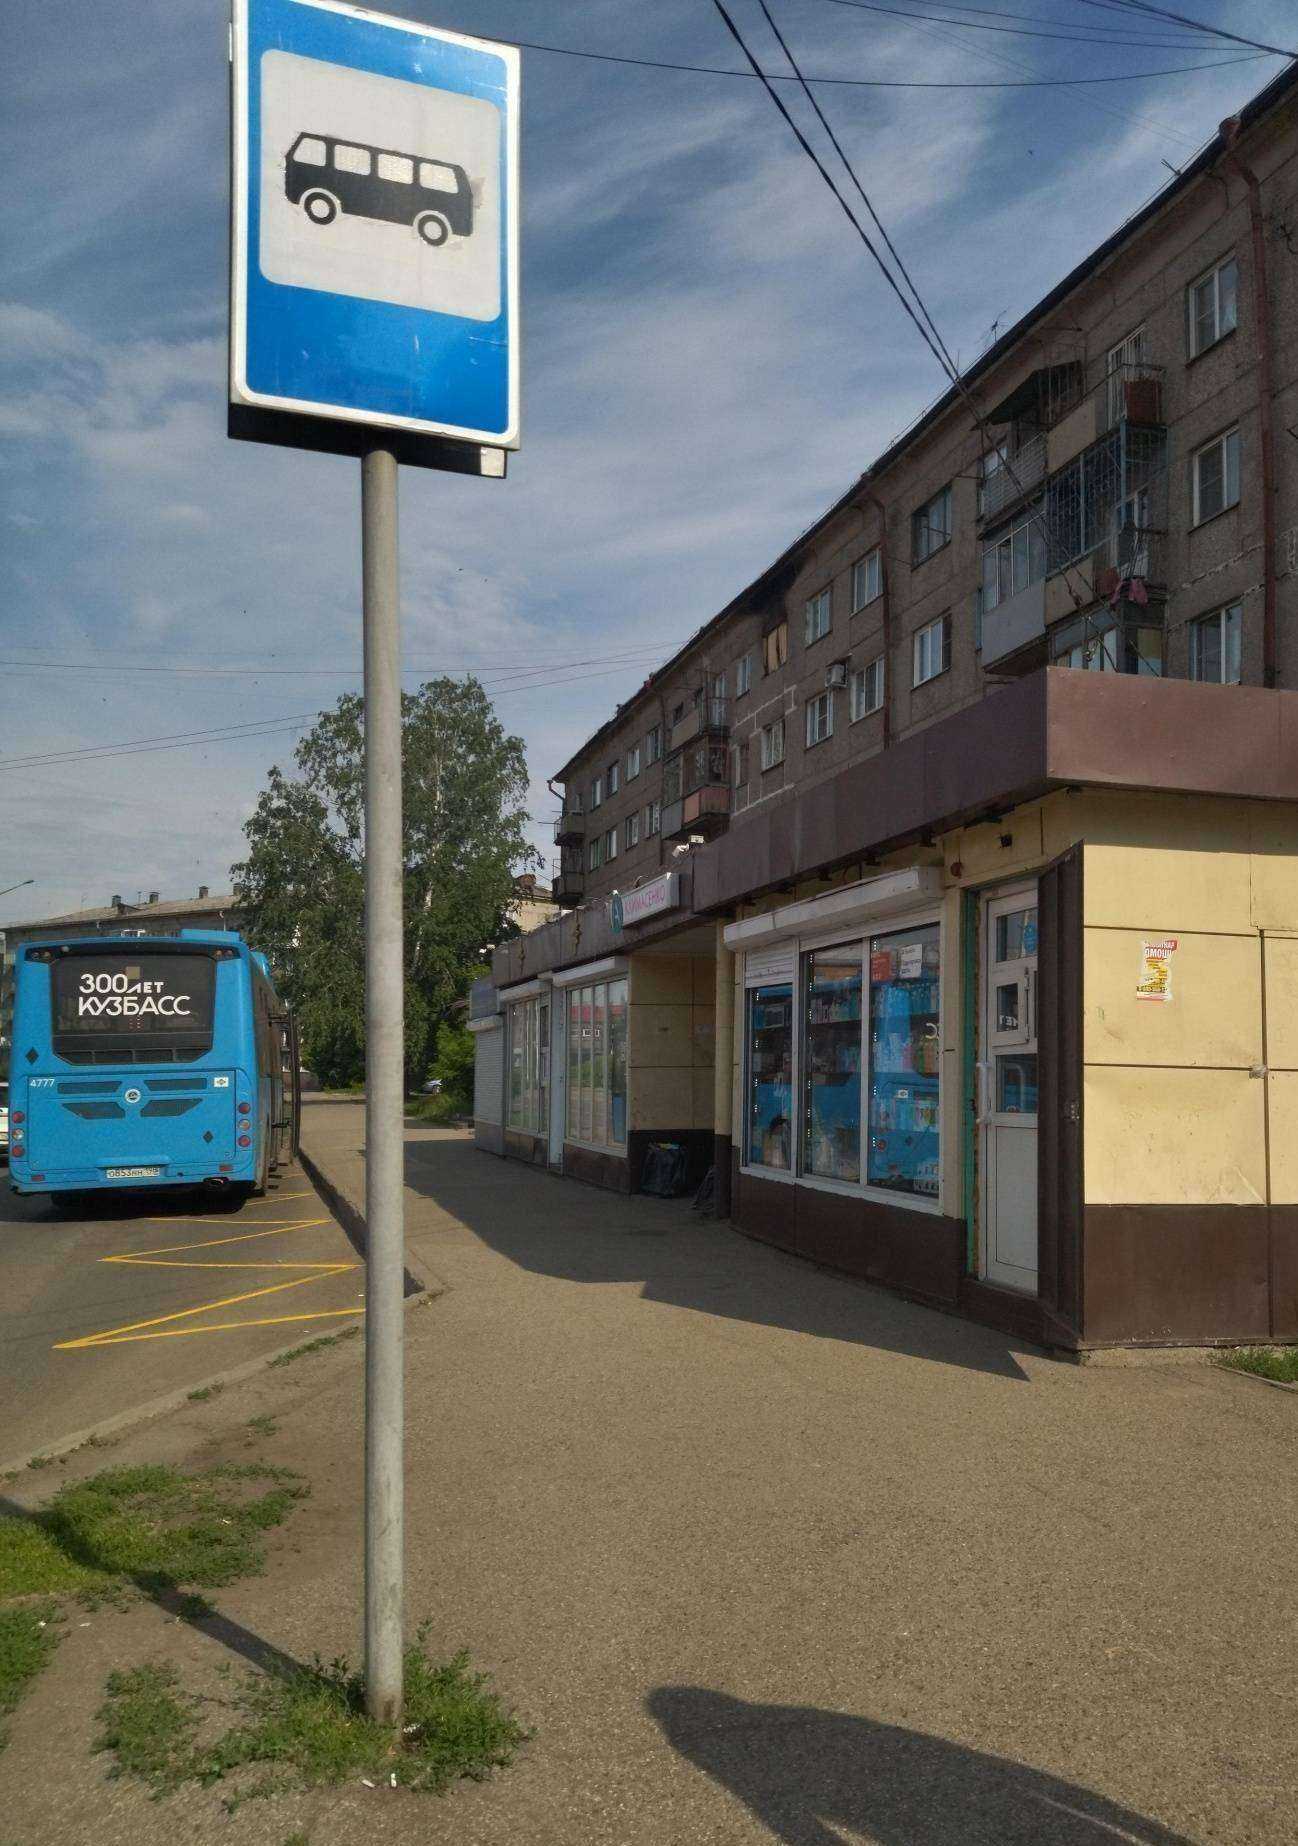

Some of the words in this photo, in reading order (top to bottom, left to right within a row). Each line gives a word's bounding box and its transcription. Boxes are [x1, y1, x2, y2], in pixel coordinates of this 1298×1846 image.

[79, 973, 128, 994] 300
[126, 981, 164, 994] ЛЕТ
[78, 995, 191, 1016] КУЗБАСС
